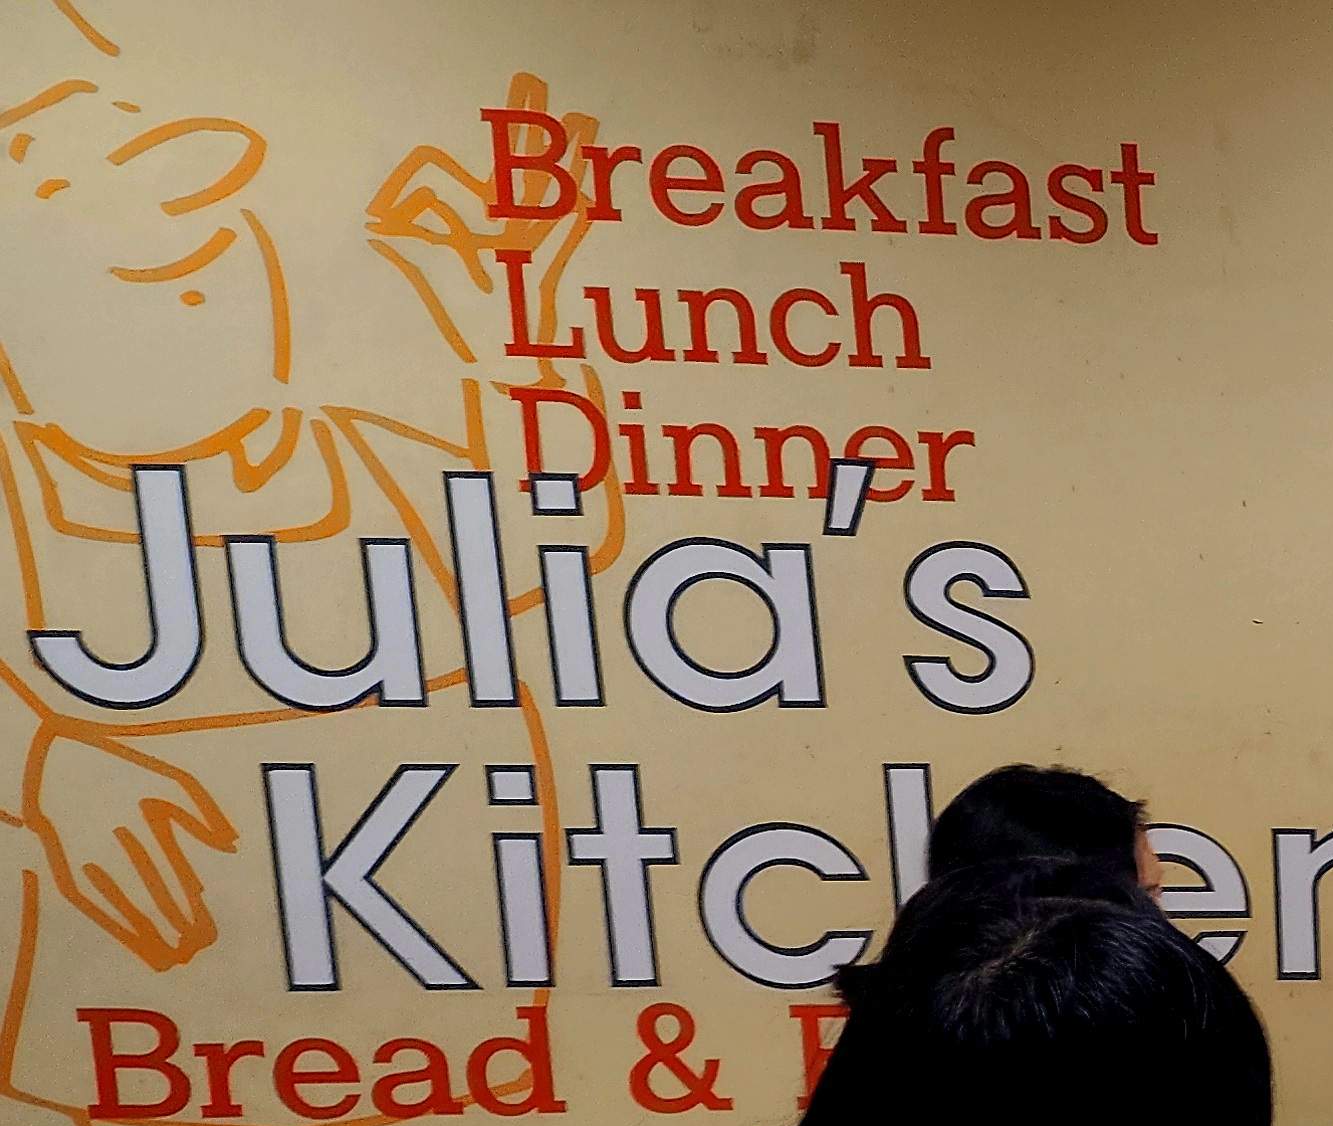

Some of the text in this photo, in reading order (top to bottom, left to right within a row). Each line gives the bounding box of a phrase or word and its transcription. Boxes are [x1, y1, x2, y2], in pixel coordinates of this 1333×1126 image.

[480, 108, 1159, 245] Breakfast
[494, 249, 931, 369] Lunch
[507, 387, 975, 503] Dinner
[26, 459, 1034, 714] Julia's
[76, 1006, 567, 1120] Bread
[629, 1002, 733, 1114] &
